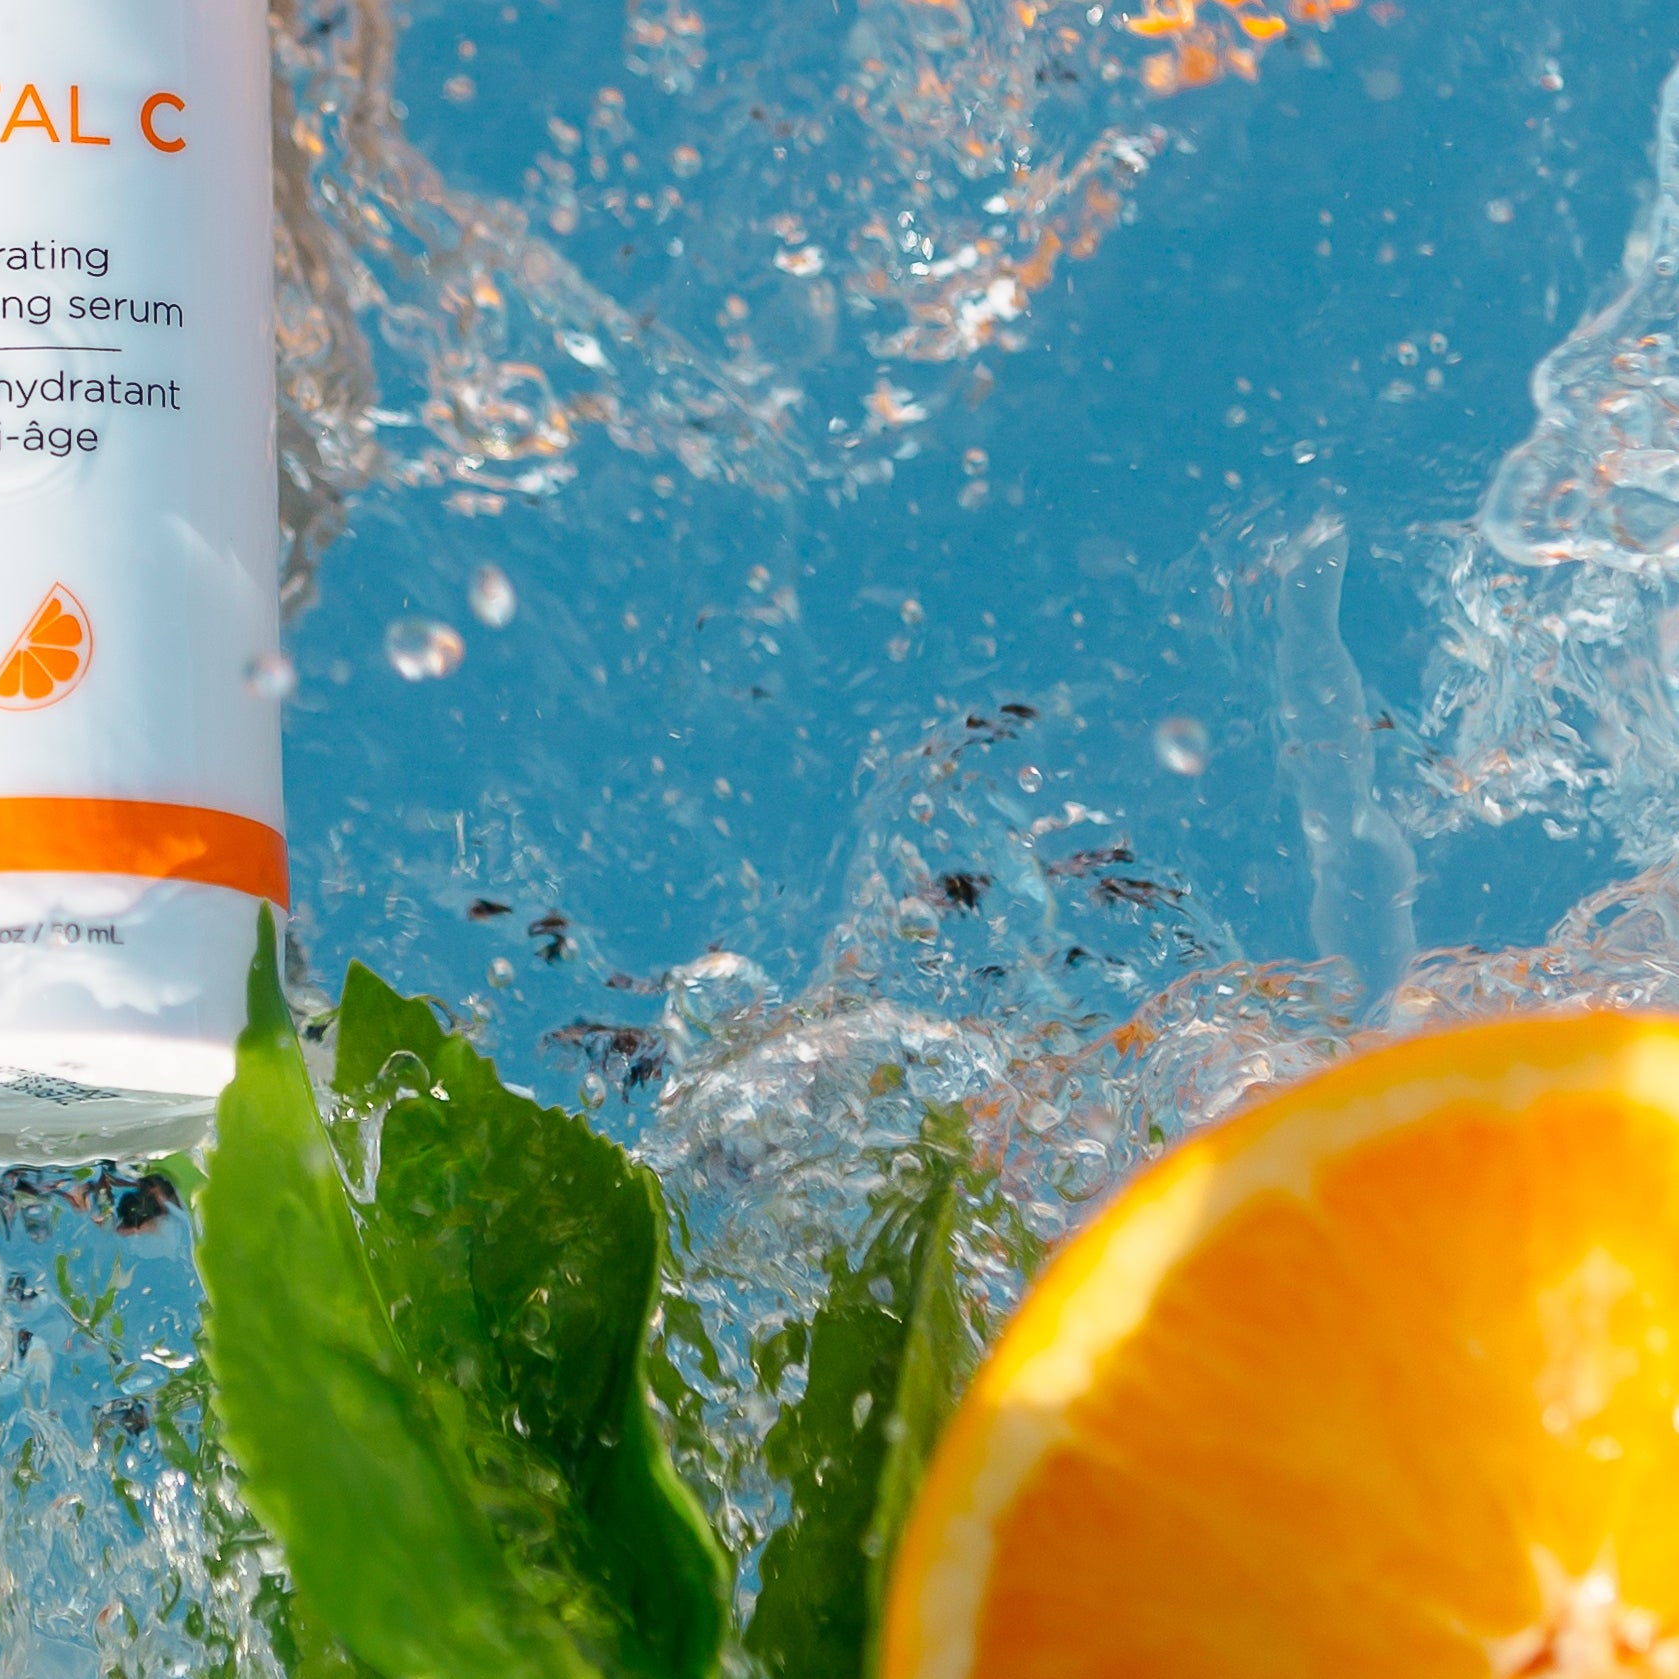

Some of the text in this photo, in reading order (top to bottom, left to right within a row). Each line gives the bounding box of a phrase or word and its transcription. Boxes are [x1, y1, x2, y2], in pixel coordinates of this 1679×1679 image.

[140, 92, 186, 153] C
[68, 295, 183, 328] serum
[31, 923, 44, 944] /
[88, 924, 125, 945] mL
